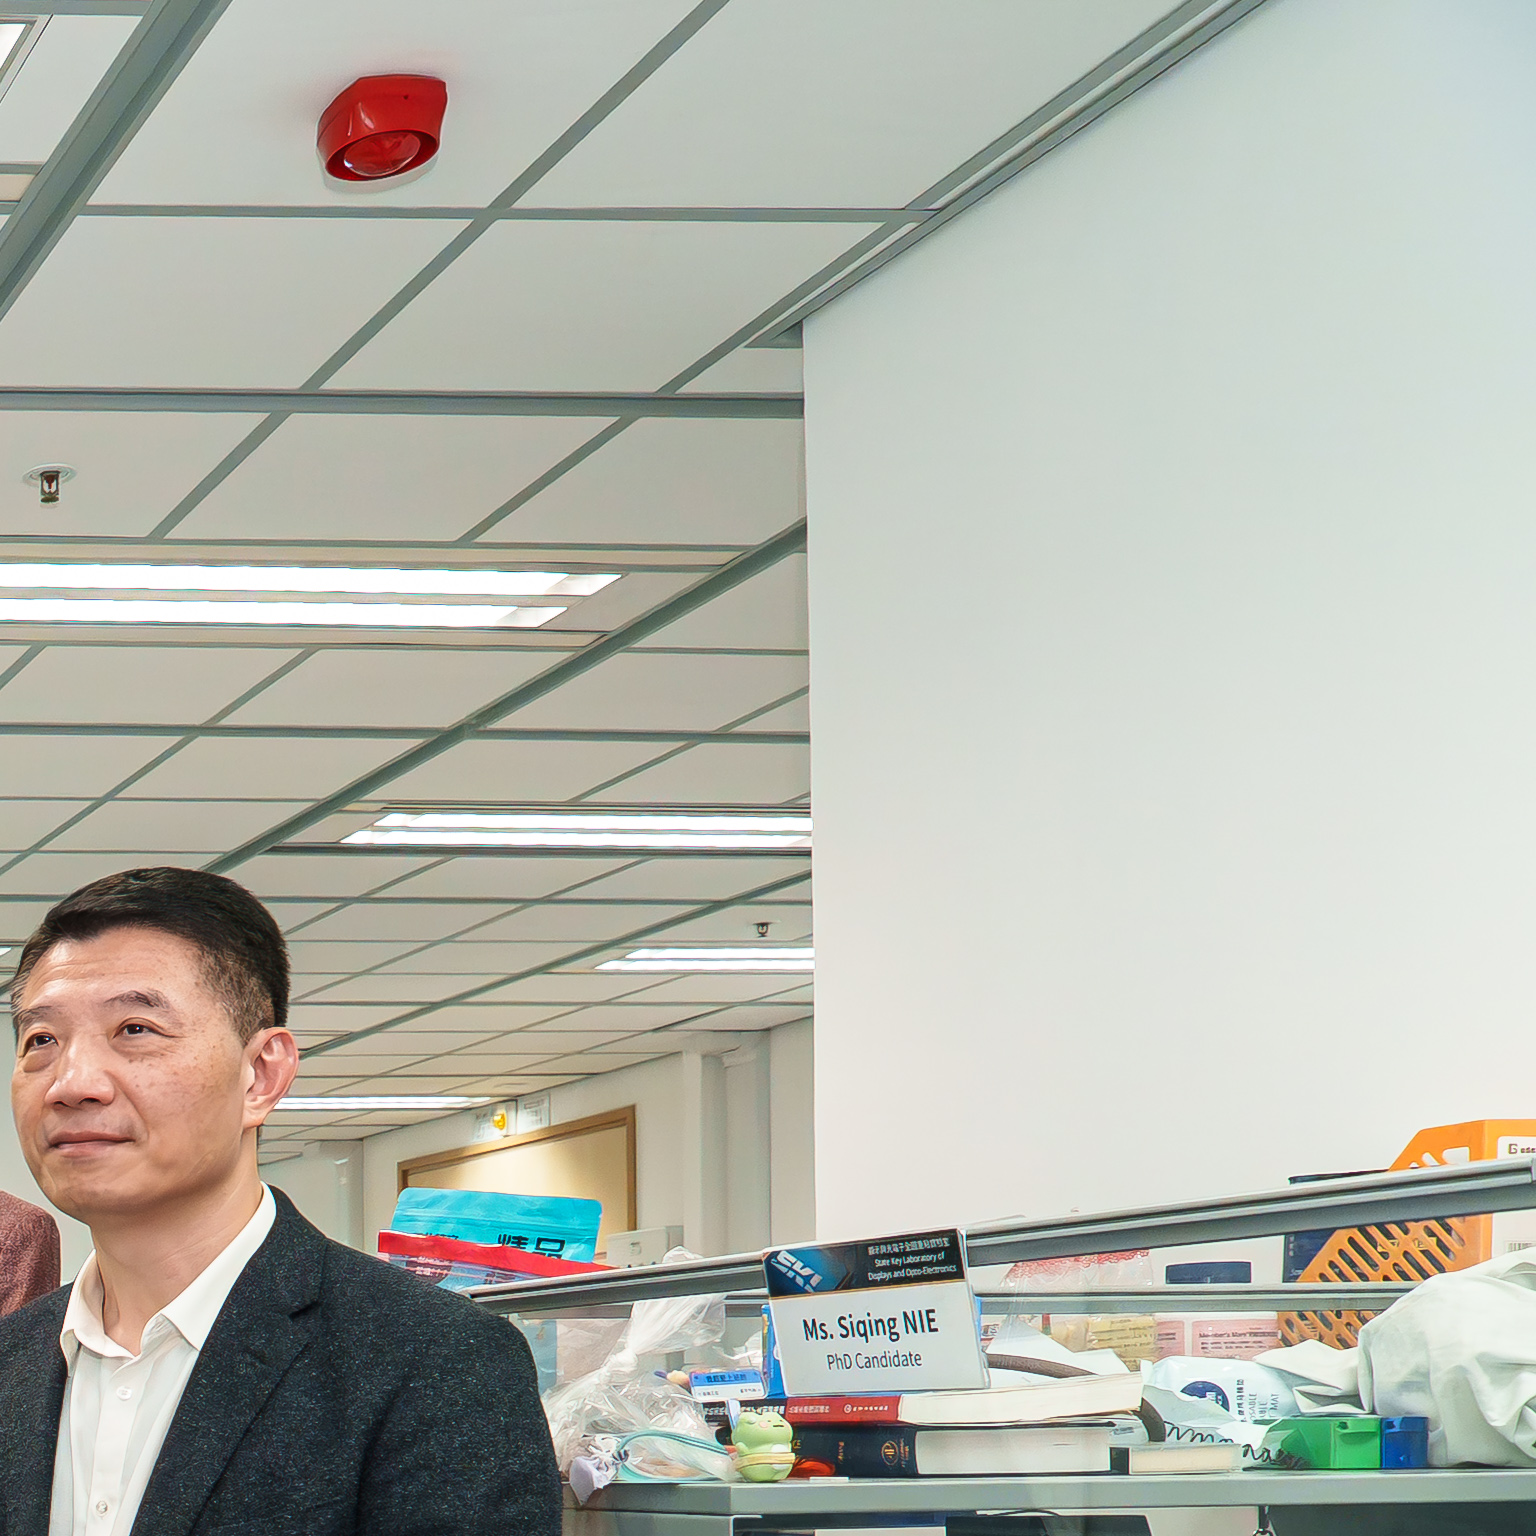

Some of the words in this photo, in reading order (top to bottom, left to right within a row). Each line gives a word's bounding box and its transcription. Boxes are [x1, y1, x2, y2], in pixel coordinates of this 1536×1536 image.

[802, 1318, 834, 1341] Ms.
[837, 1312, 901, 1343] Siqing
[902, 1308, 939, 1335] NIE
[826, 1353, 852, 1370] PhD
[855, 1350, 923, 1369] Candidate
